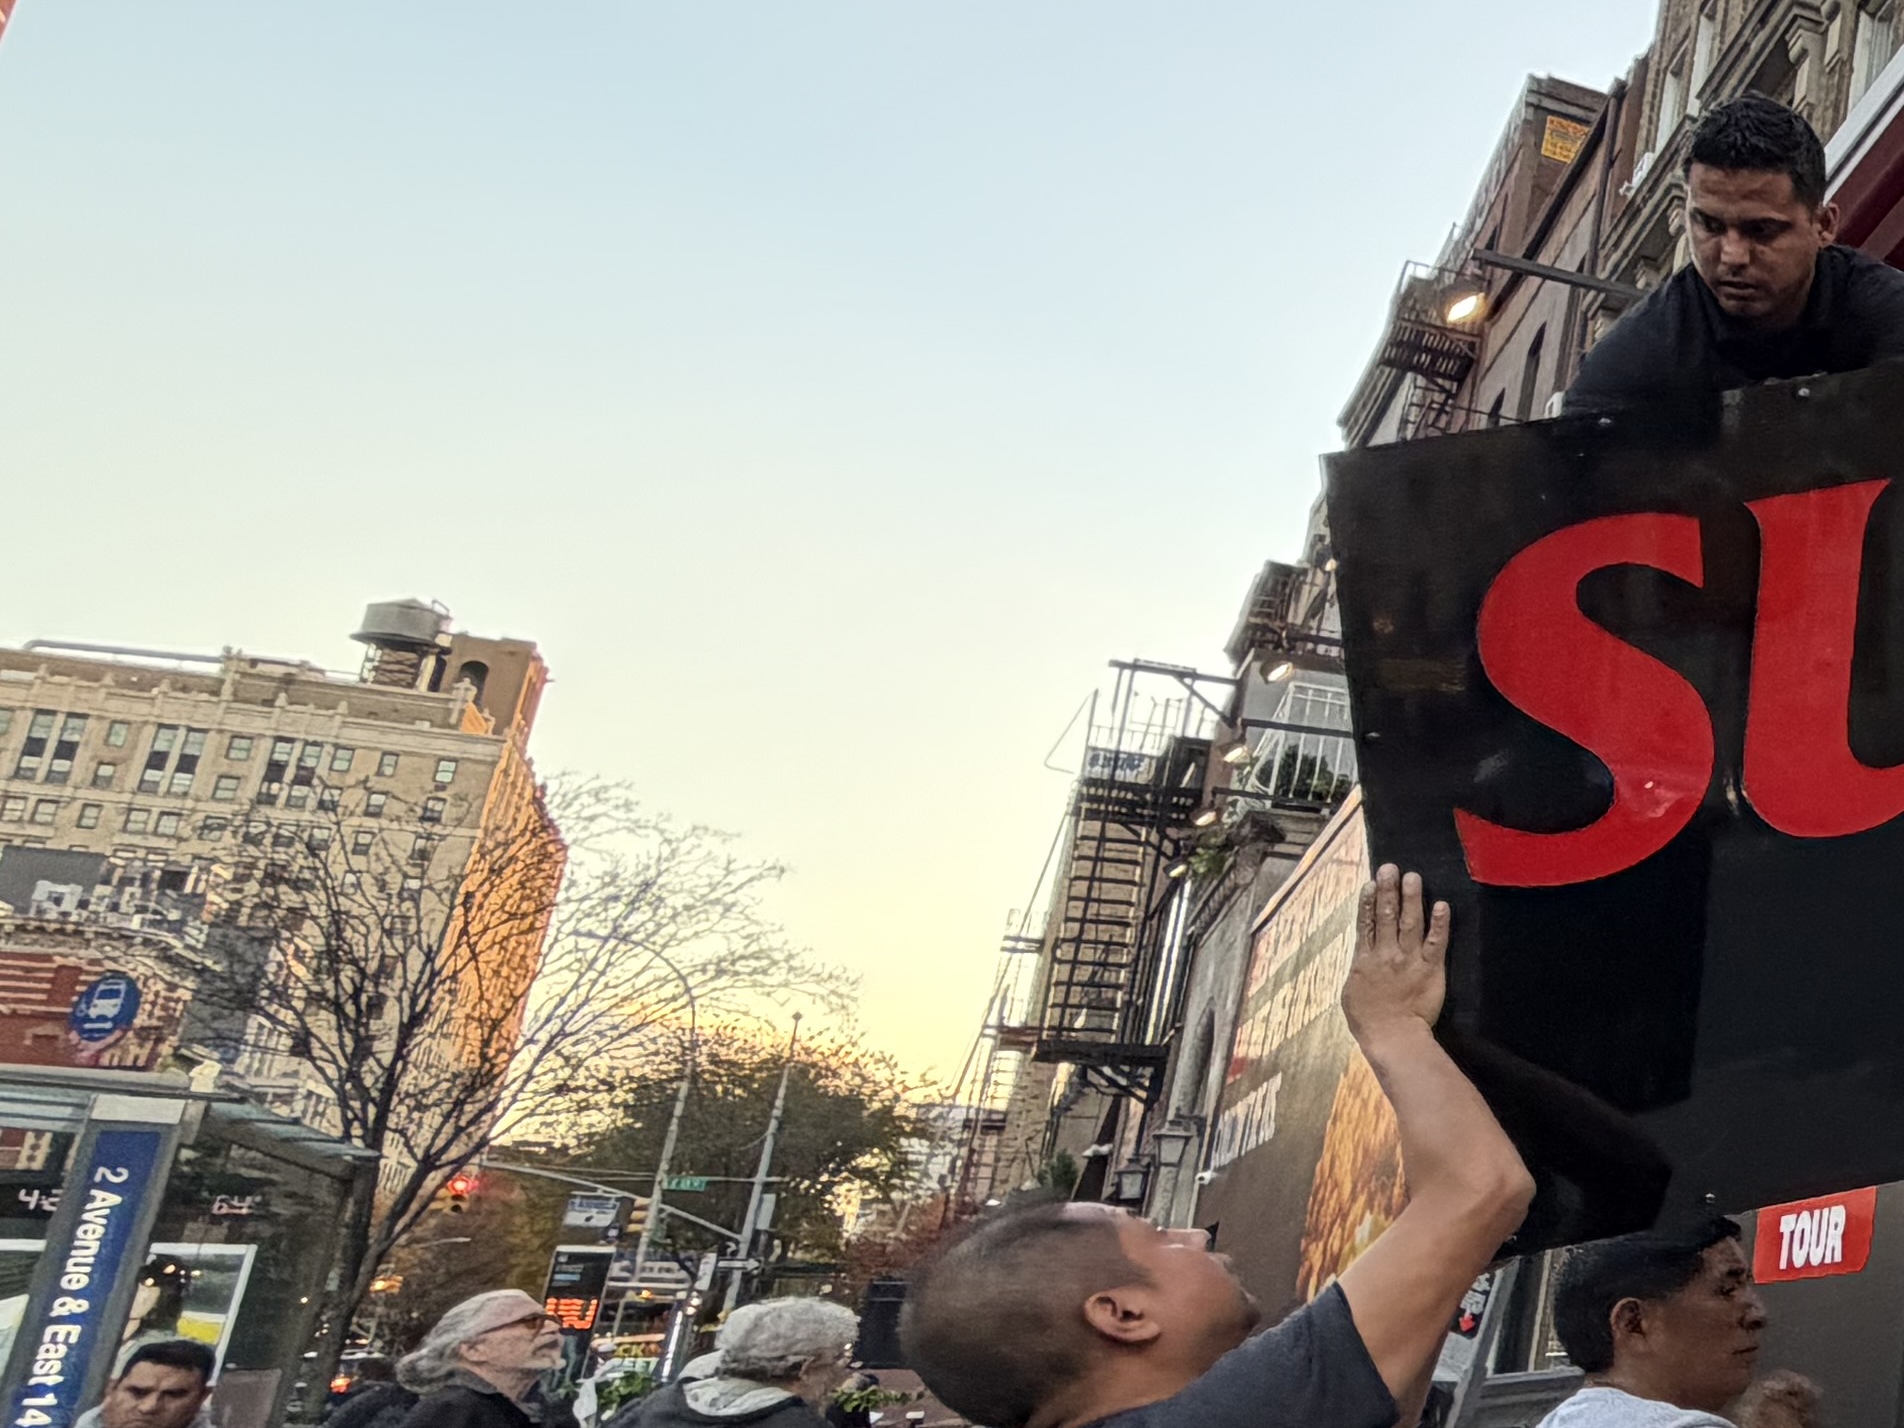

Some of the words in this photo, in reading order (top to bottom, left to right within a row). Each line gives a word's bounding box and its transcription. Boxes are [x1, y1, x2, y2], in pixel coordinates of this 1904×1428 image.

[97, 1166, 129, 1184] 2
[60, 1188, 123, 1291] Avenue
[1778, 1204, 1848, 1271] TOUR
[49, 1296, 90, 1318] &
[27, 1324, 82, 1387] East
[14, 1392, 58, 1428] 14
